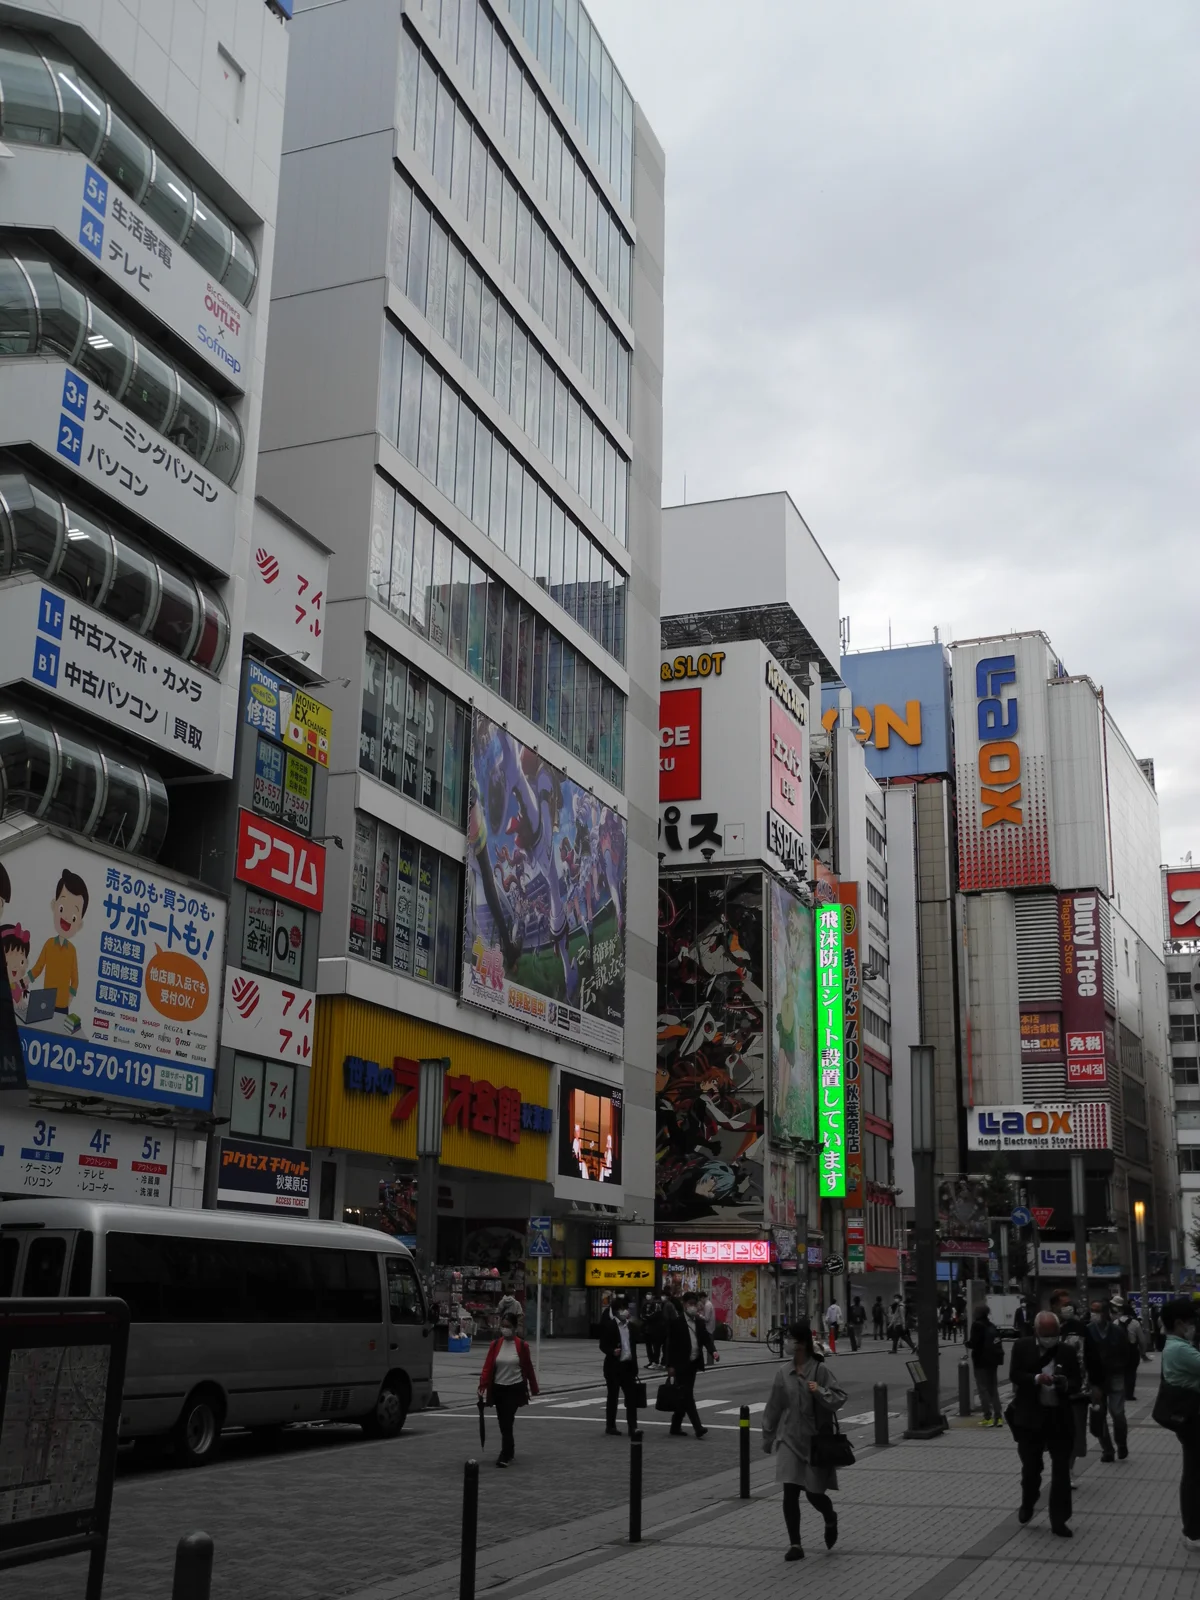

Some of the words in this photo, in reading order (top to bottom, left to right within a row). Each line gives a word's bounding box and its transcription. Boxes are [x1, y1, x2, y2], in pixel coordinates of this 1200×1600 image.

[87, 176, 105, 205] 5F
[82, 220, 102, 248] 4F
[112, 198, 172, 269] 生活家電
[109, 241, 153, 291] テレビ
[207, 283, 240, 320] BicCamera
[204, 295, 240, 337] OUTLET
[197, 325, 241, 374] Sofmap
[67, 380, 85, 409] 3F
[62, 424, 80, 453] 2F
[94, 399, 218, 503] ゲーミングパソコン
[88, 444, 148, 497] パソコン
[297, 575, 322, 609] アイ
[44, 600, 61, 628] 1F
[295, 605, 322, 637] フル
[38, 653, 56, 677] B1
[69, 615, 202, 703] 中古スマホ・カメラ
[250, 665, 278, 693] iPhone
[64, 662, 158, 725] 中古パソコン
[174, 717, 203, 751] 買取
[296, 693, 321, 717] MONEY
[364, 654, 434, 734] K-BOOKS
[247, 697, 277, 737] 修理
[259, 744, 282, 772] 即日
[772, 732, 802, 783] エスパス
[262, 767, 277, 782] 修理
[255, 777, 282, 801] 03-557
[285, 792, 310, 814] 7-5547
[262, 796, 280, 814] 10:00
[767, 811, 808, 872] ESPACE
[242, 827, 318, 896] アコム
[103, 893, 215, 961] サポートも!
[846, 909, 855, 931] ZOO
[1061, 898, 1073, 942] Flagship
[1073, 897, 1097, 945] Duty
[103, 935, 141, 960] 持込修理
[1064, 944, 1074, 974] Store
[101, 959, 139, 984] 訪問修理
[149, 966, 207, 995] 他店購入品でも
[580, 953, 625, 1011] 伝説となる
[844, 948, 858, 1017] まぁじゃん
[1076, 949, 1099, 998] Free
[98, 984, 138, 1008] 買取・下取
[160, 988, 196, 1010] 受付OK!
[280, 989, 312, 1025] アイ
[94, 1006, 116, 1018] Panasonic
[120, 1013, 138, 1023] TOSHIBA
[142, 1019, 160, 1028] SHARP
[164, 1024, 184, 1034] REGZA
[94, 1018, 109, 1027] Lenovo
[118, 1025, 136, 1034] DAIKIN
[141, 1029, 155, 1039] dyson
[180, 1039, 191, 1047] msi
[1021, 1014, 1040, 1024] 本店
[1021, 1023, 1060, 1035] 総合家電
[92, 1032, 109, 1041] ASUS
[134, 1041, 152, 1051] SONY
[156, 1046, 171, 1055] Canon
[175, 1050, 188, 1058] Nikon
[278, 1028, 312, 1060] フル
[819, 910, 844, 1192] 飛沫防止シート設置しています
[845, 1019, 859, 1082] ZOO
[1070, 1036, 1101, 1052] 免税
[186, 1073, 199, 1093] B1
[1070, 1063, 1103, 1077] 면세점
[269, 1081, 289, 1101] アイ
[344, 1055, 395, 1097] 世界の
[391, 1056, 521, 1145] ラオ会館
[520, 1102, 553, 1134] 秋葉原
[267, 1102, 288, 1121] フル
[846, 1083, 860, 1154] 秋葉原店
[33, 1120, 57, 1147] 3F
[89, 1128, 111, 1154] 4F
[978, 1137, 1002, 1146] Home
[1004, 1136, 1048, 1146] Electronics
[1051, 1136, 1074, 1145] Store
[35, 1151, 50, 1160] 新品
[85, 1157, 112, 1167] アウトレット
[141, 1136, 161, 1160] 5F
[25, 1164, 62, 1176] ゲーミング
[84, 1170, 105, 1180] テレビ
[137, 1163, 162, 1173] アウトレット
[222, 1150, 309, 1176] アクセスチケット
[24, 1176, 53, 1188] パソコン
[83, 1183, 115, 1193] レコーダー
[140, 1187, 160, 1198] 洗濯機
[141, 1175, 160, 1186] 冷蔵庫
[276, 1174, 309, 1193] 秋葉原店
[275, 1196, 292, 1206] ACCESS
[292, 1198, 306, 1207] TICKET
